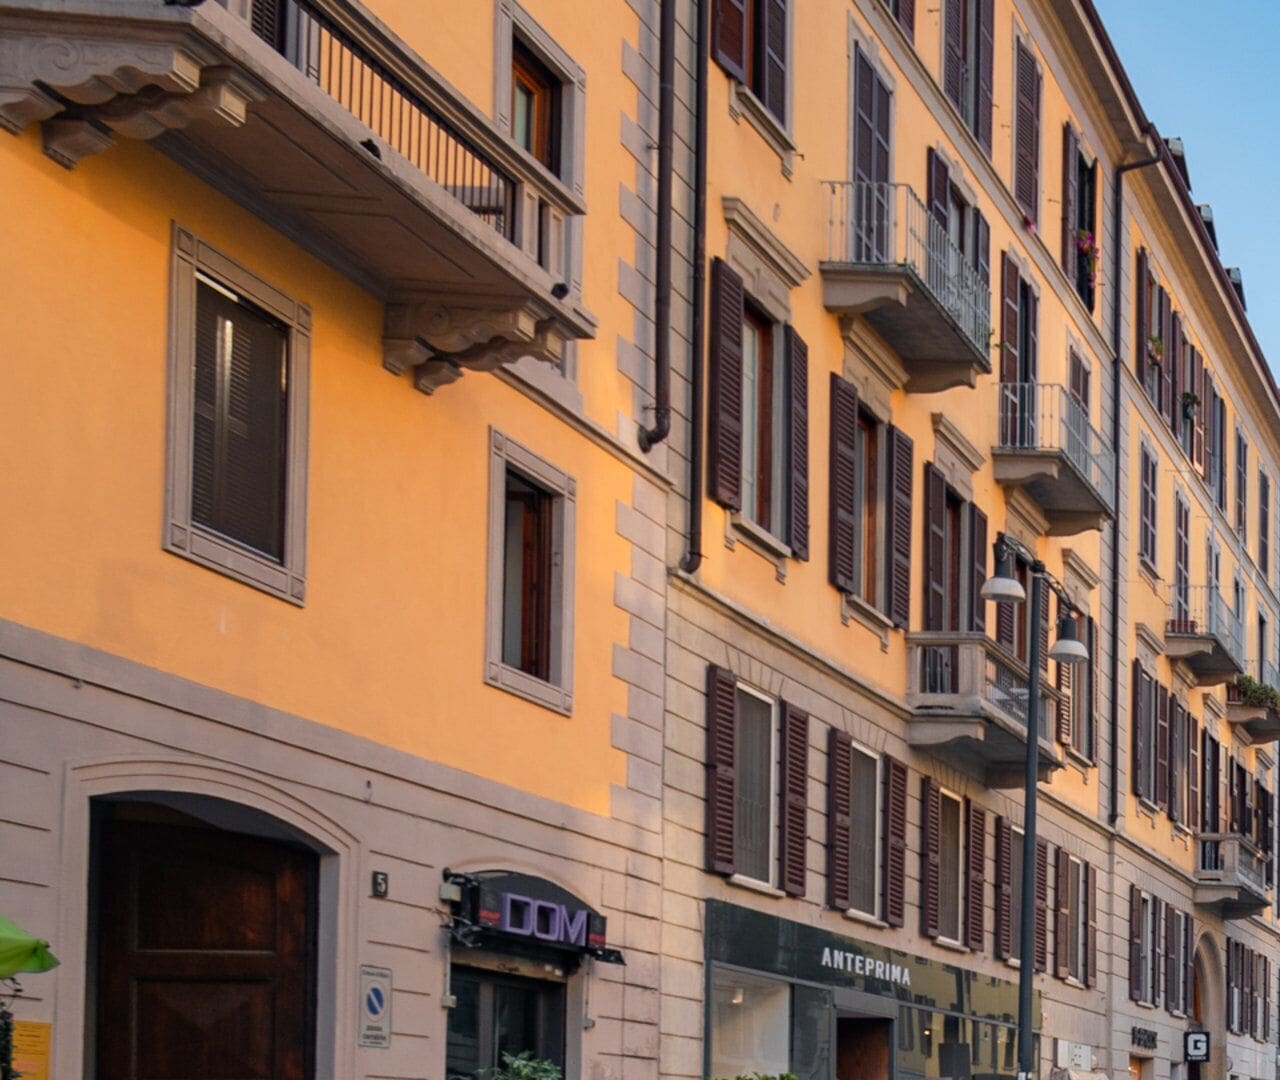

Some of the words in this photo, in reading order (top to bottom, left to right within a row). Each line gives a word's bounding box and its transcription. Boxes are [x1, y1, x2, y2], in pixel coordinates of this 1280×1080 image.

[376, 873, 386, 893] 5
[502, 892, 588, 947] DOM
[821, 947, 911, 986] ANTEPRIMA
[1187, 1033, 1207, 1056] G
